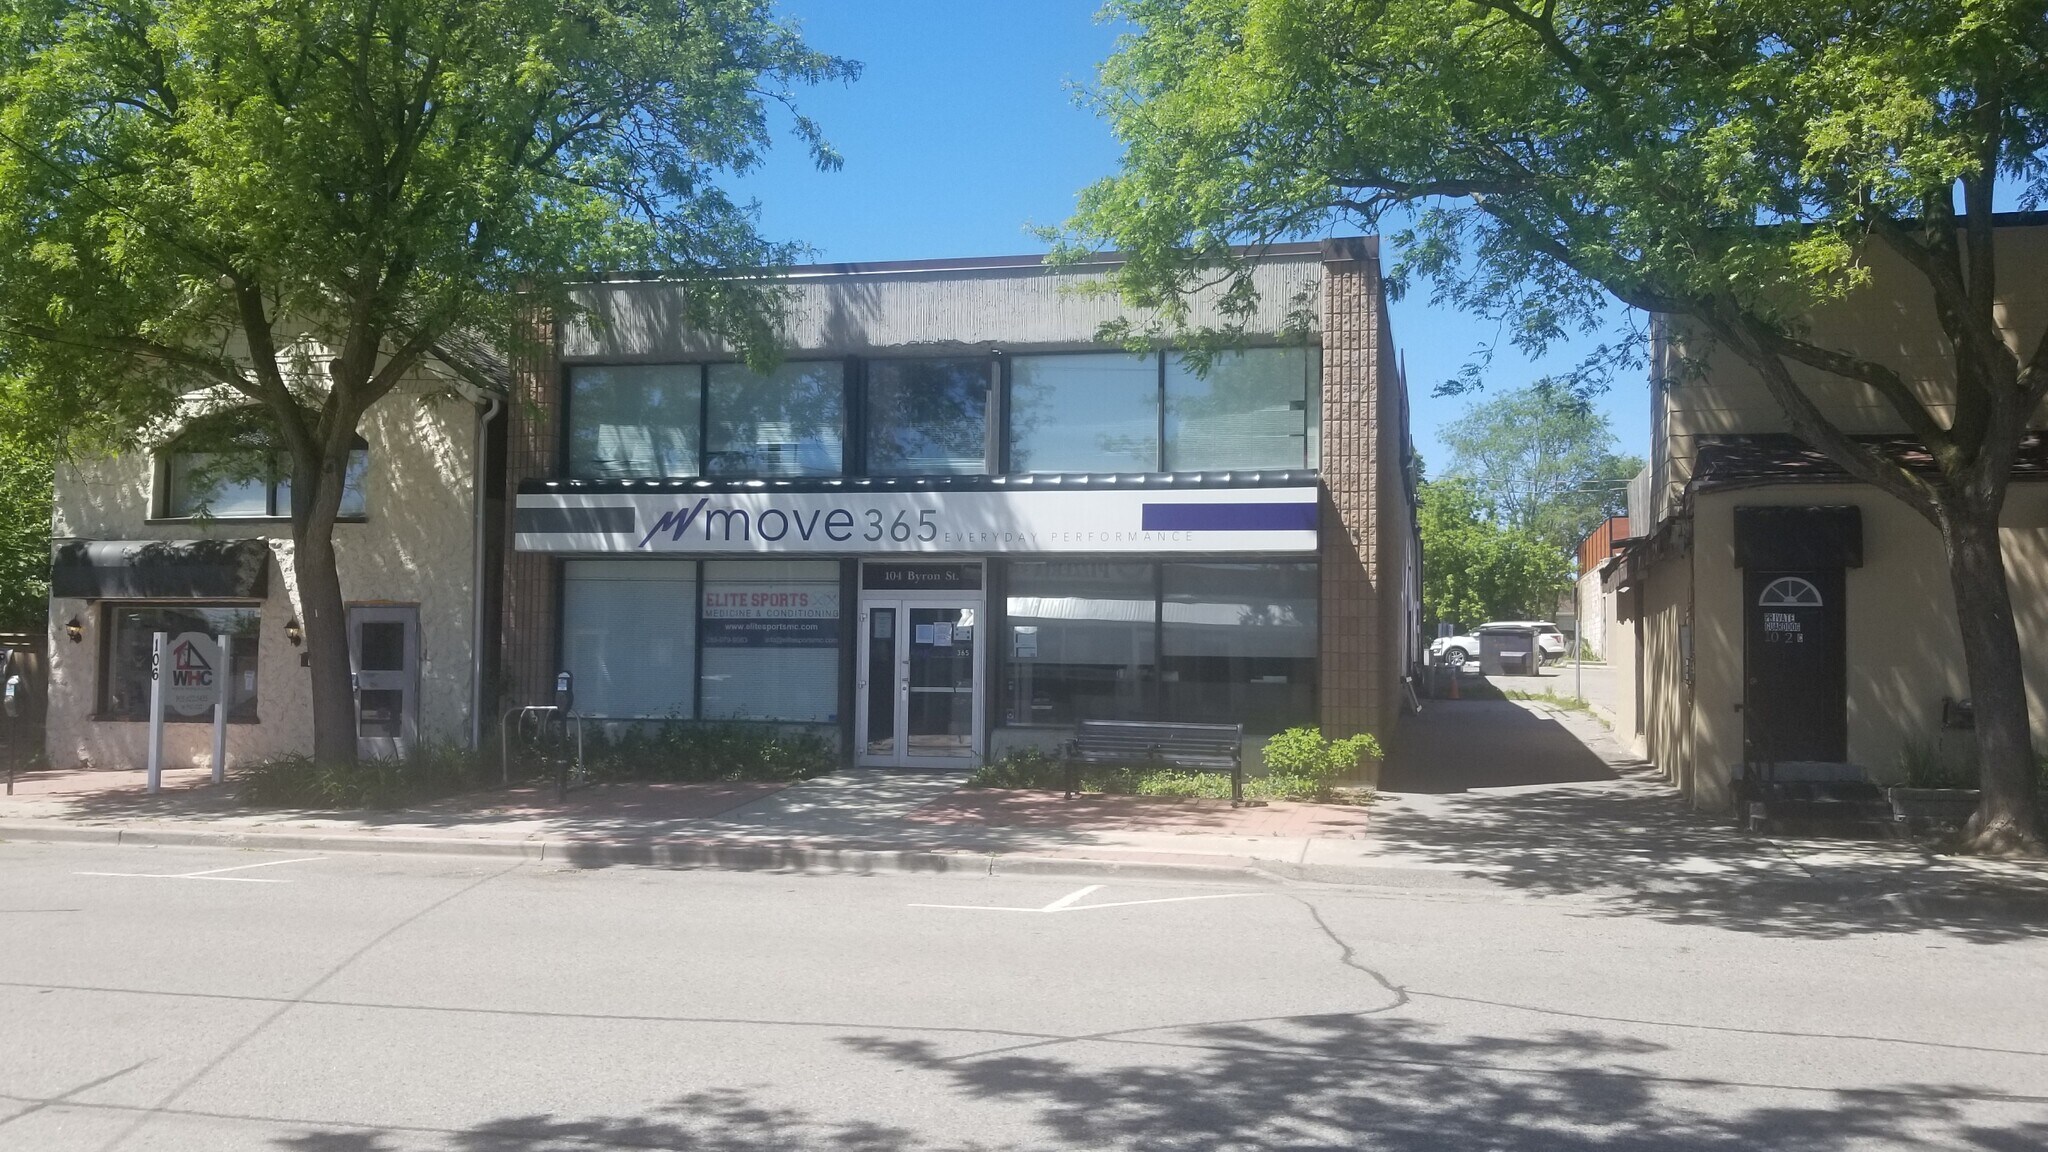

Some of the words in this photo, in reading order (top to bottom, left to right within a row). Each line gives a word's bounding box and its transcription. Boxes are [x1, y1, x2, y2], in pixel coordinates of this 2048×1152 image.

[705, 508, 854, 541] move
[863, 508, 937, 542] 365
[945, 532, 1038, 543] EVERYDAY
[1051, 531, 1193, 543] PERFORMANCE
[907, 570, 941, 583] Byron
[945, 570, 960, 581] St.
[706, 592, 748, 607] ELITE
[751, 592, 809, 607] SPORTS
[705, 609, 751, 618] MEDICINE
[766, 609, 839, 618] CONDITIONING
[1764, 613, 1795, 622] PRIVATE
[725, 622, 818, 631] www.elitesportsmc.com
[152, 638, 160, 681] 106
[172, 670, 213, 686] WHC
